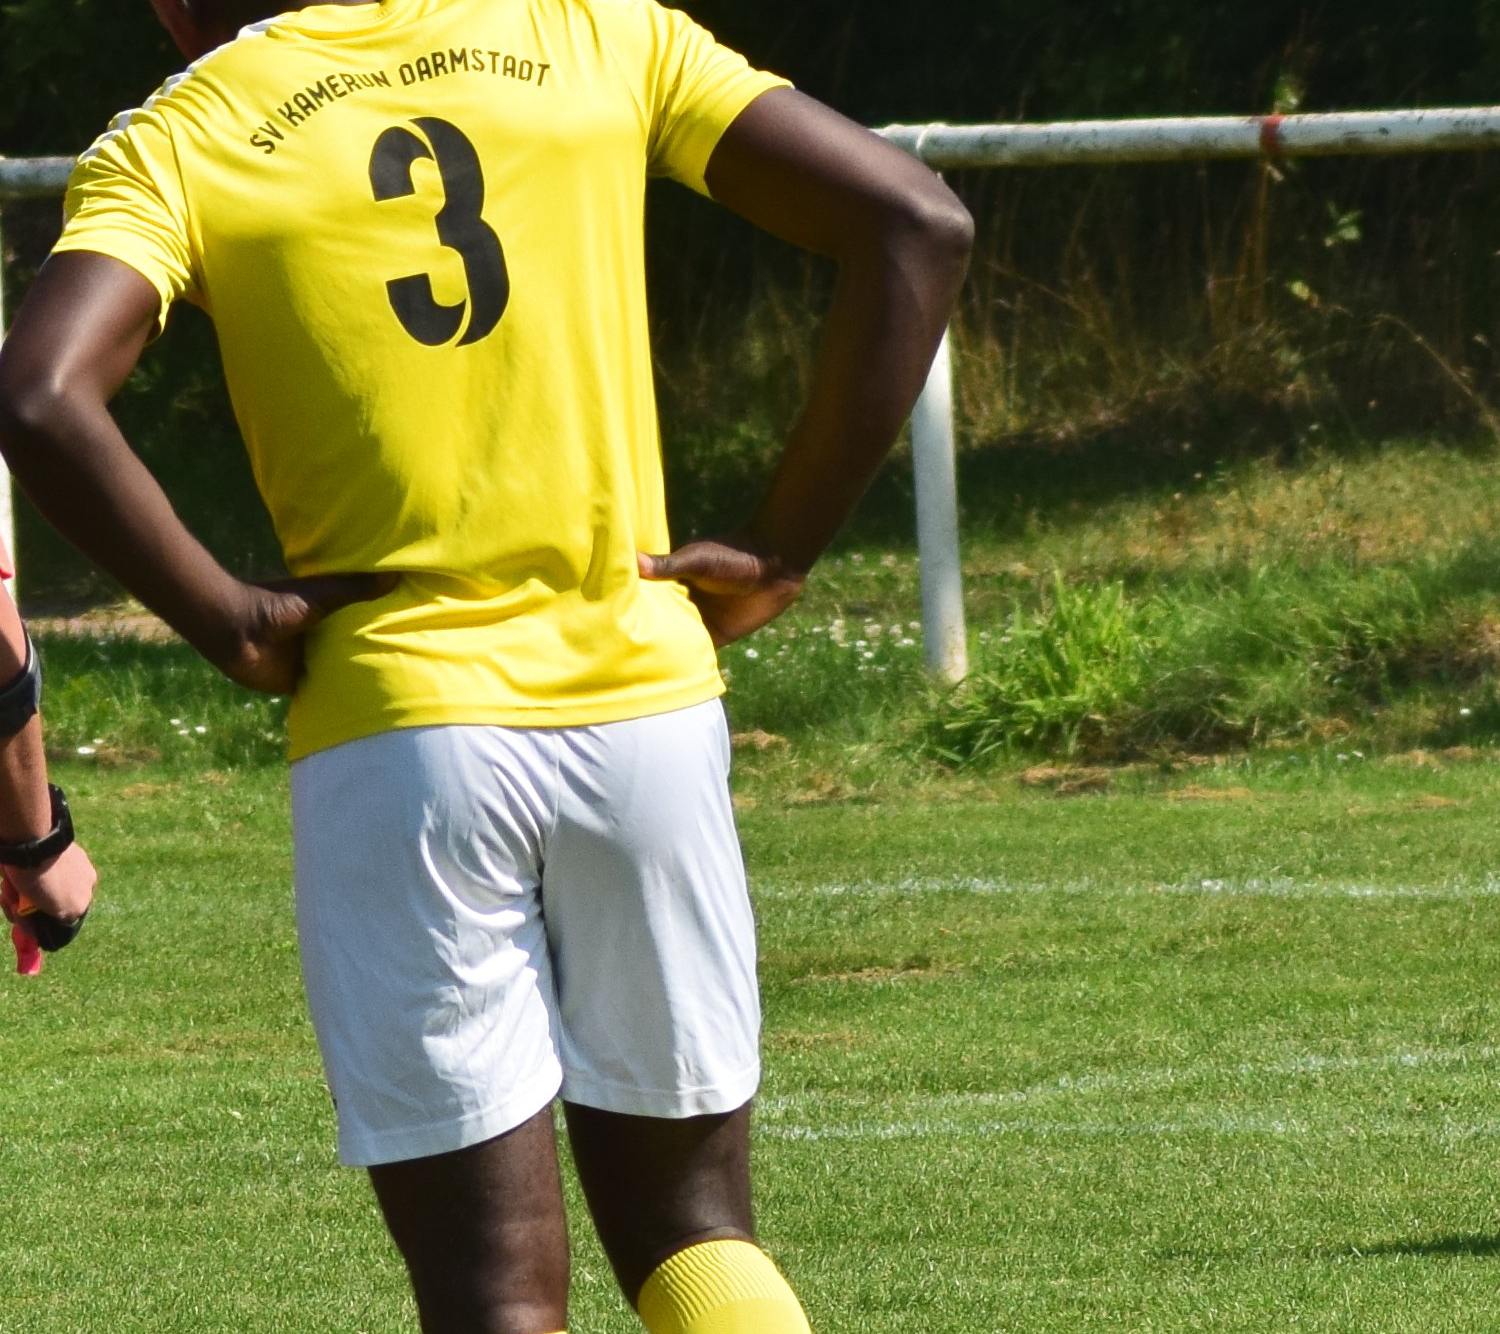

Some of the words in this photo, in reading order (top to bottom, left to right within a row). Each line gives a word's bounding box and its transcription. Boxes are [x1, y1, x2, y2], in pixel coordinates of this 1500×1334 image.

[250, 120, 285, 154] SV
[277, 70, 393, 127] KAMERUN
[398, 47, 551, 87] DARMSTADT
[368, 116, 510, 347] 3
